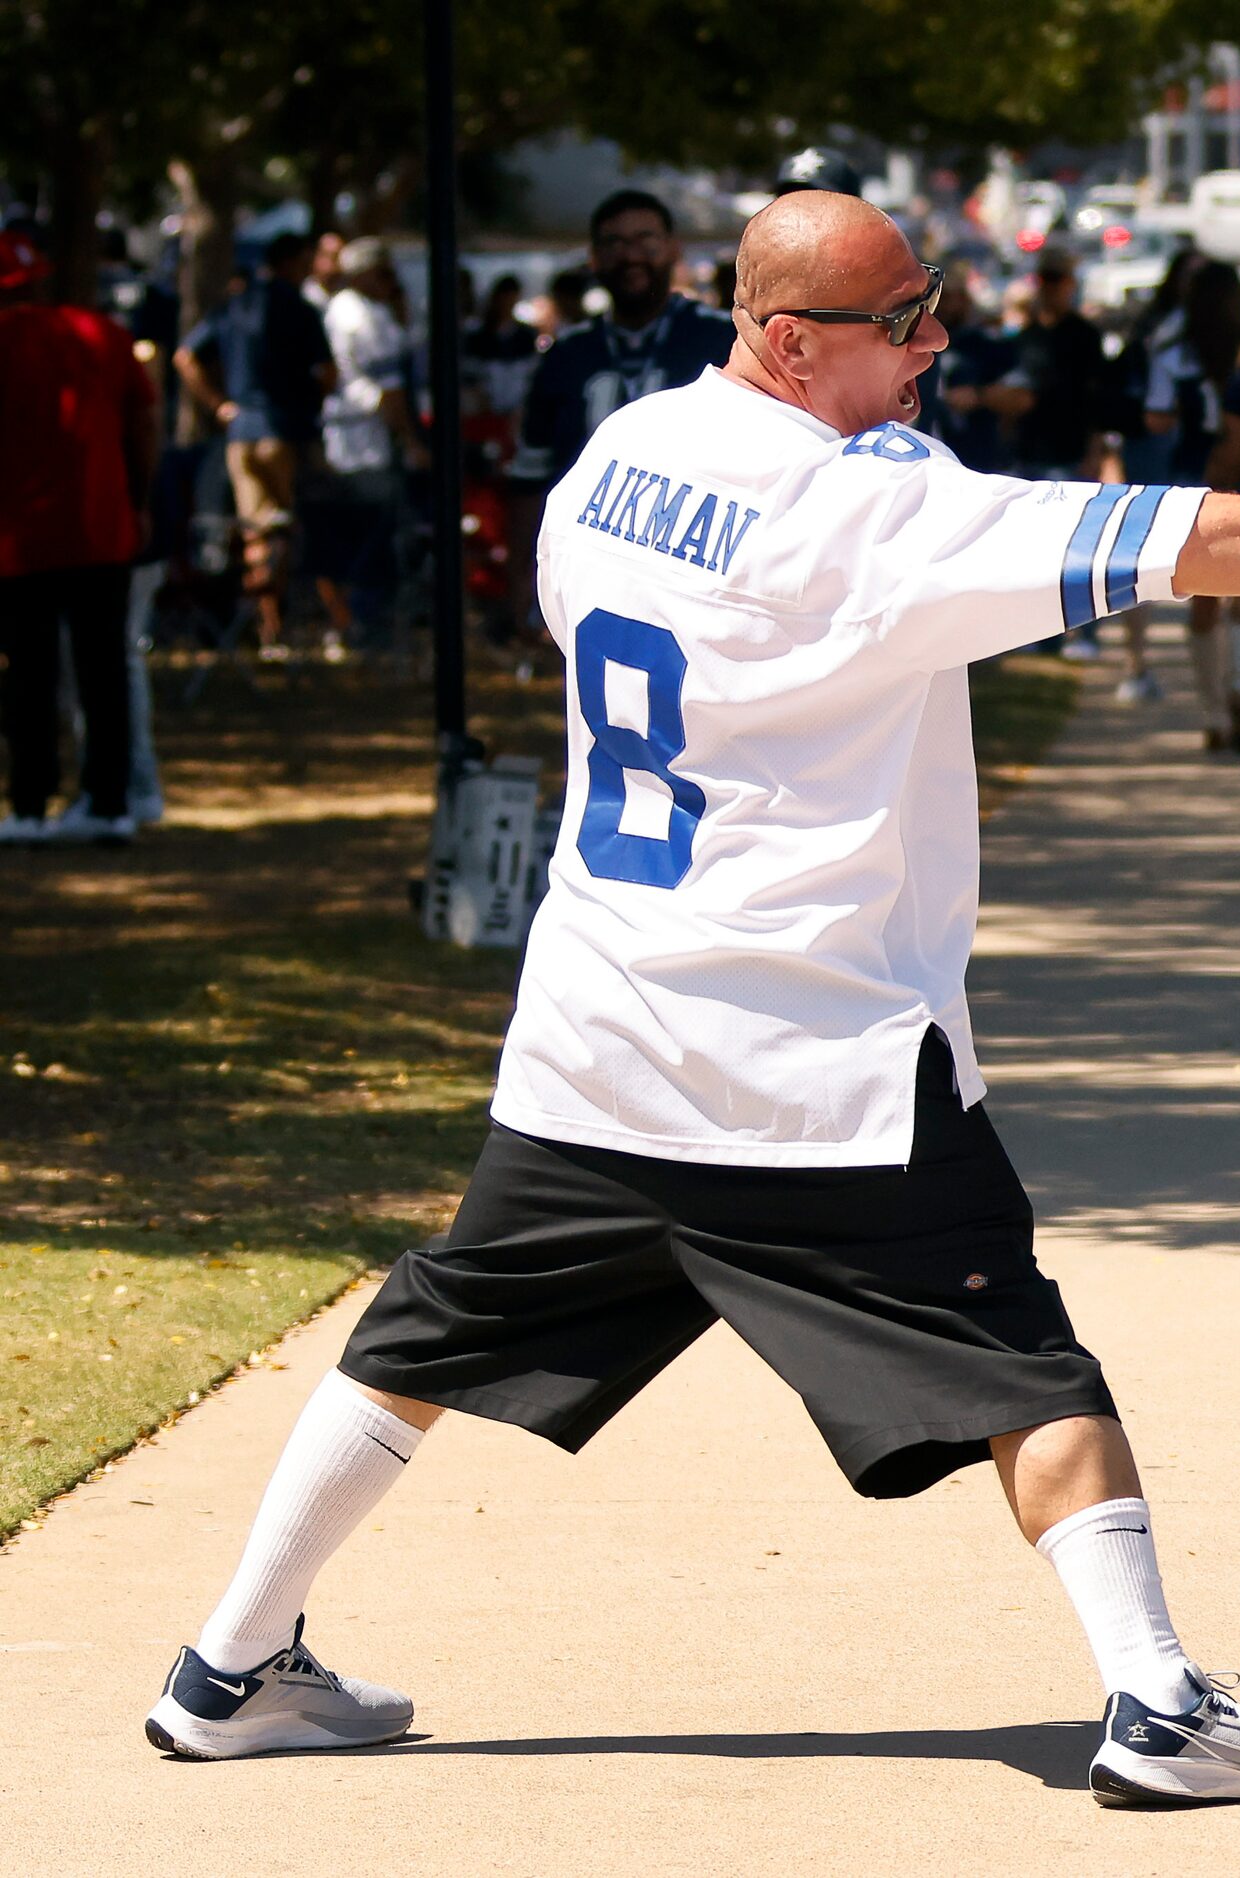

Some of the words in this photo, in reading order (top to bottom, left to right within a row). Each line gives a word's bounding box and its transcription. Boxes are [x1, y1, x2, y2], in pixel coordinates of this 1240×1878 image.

[842, 422, 930, 462] 8
[577, 459, 761, 576] AIKMAN
[575, 607, 706, 890] 8
